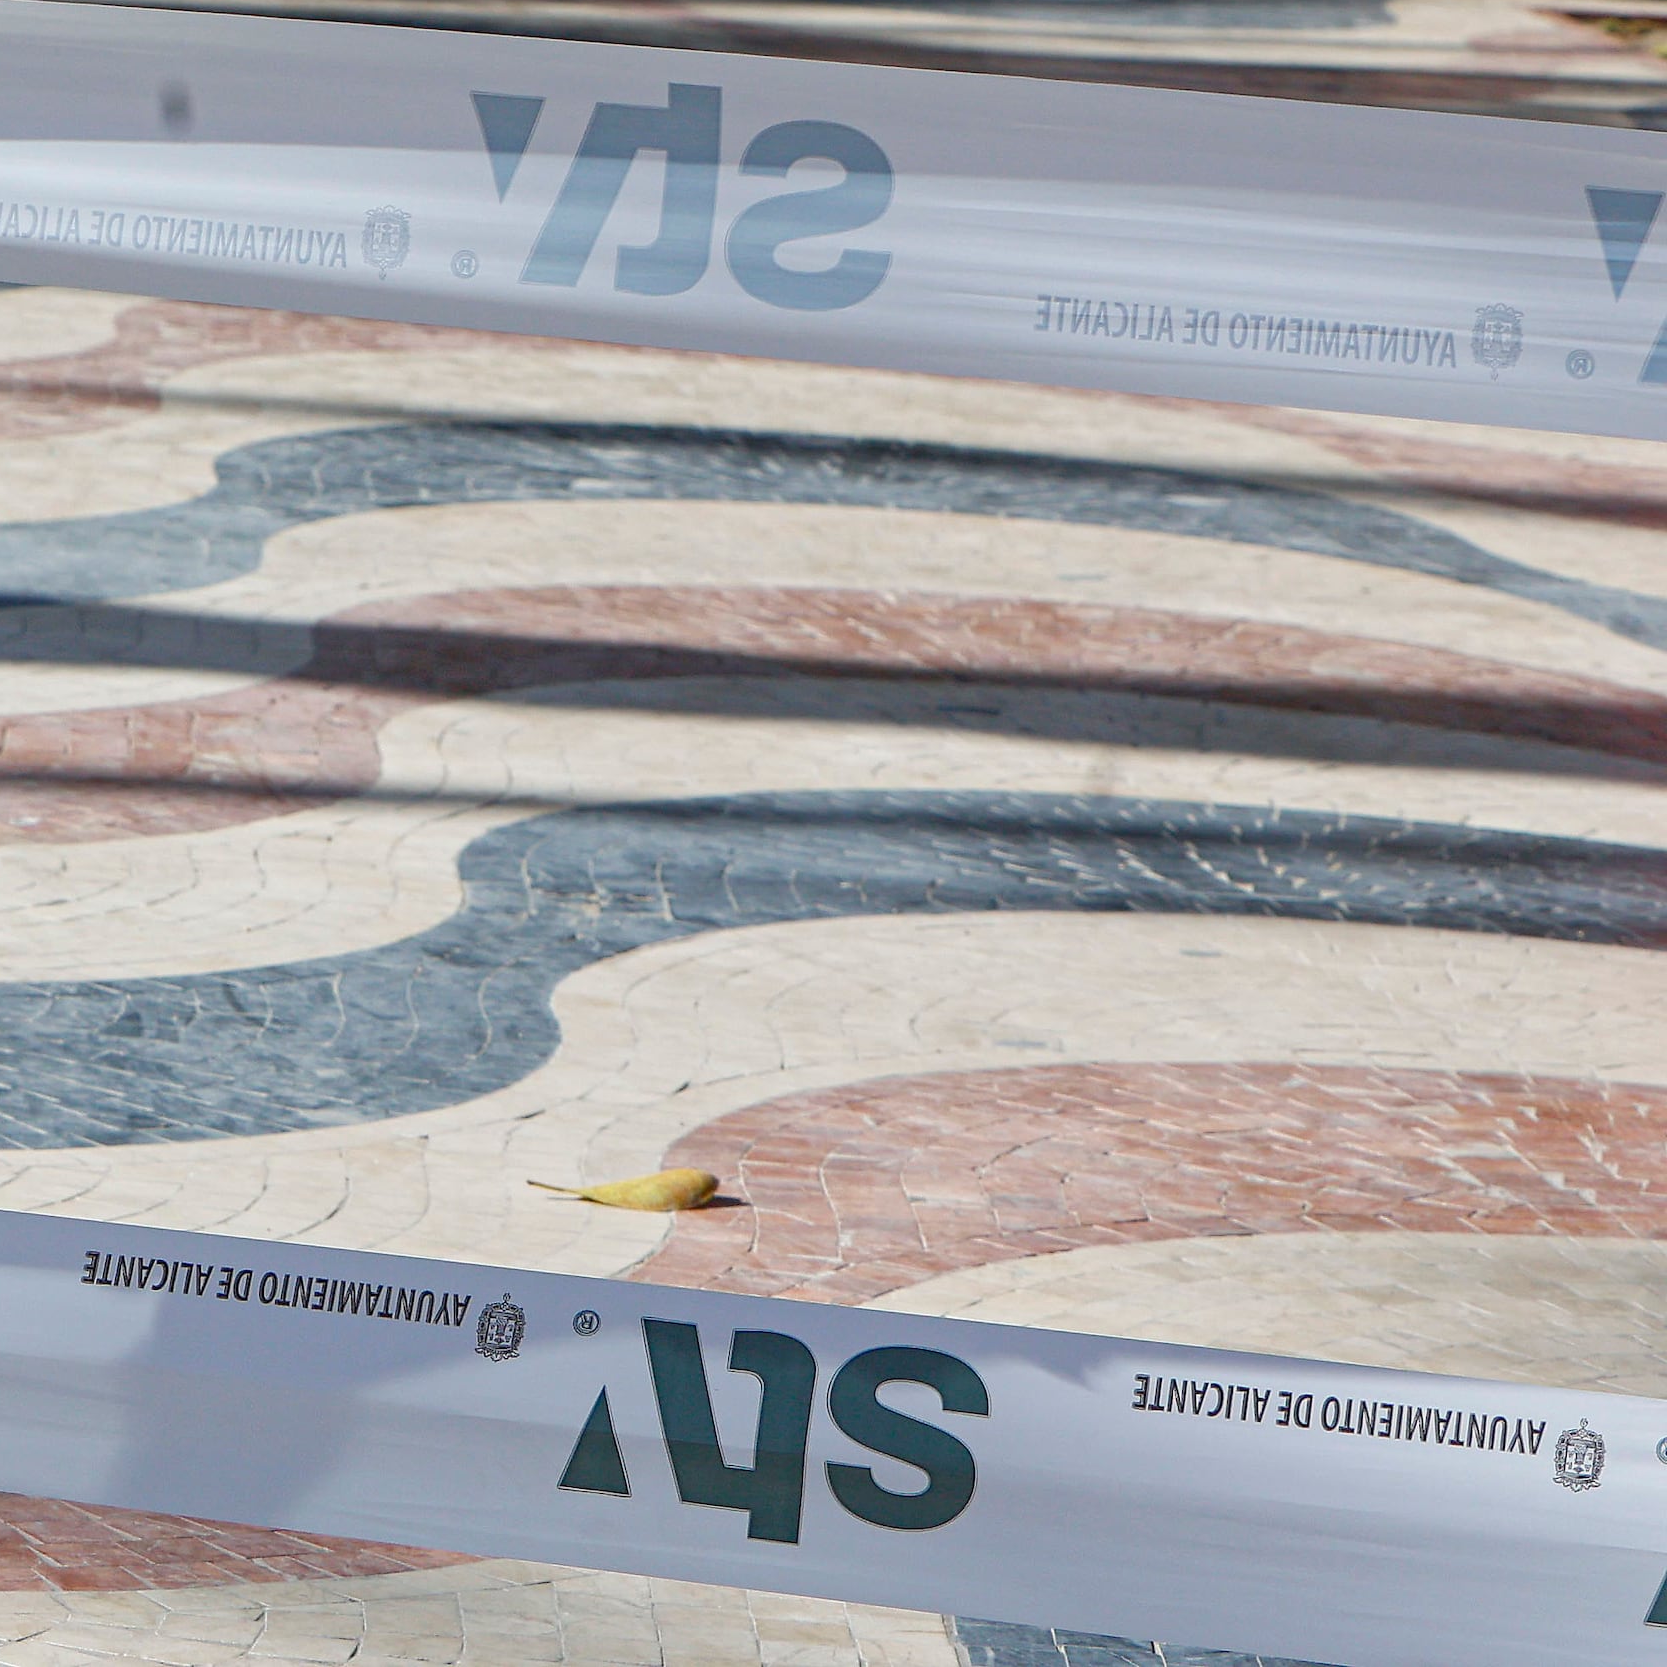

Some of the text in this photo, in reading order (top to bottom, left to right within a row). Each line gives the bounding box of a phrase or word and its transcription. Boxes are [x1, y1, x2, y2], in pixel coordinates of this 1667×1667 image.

[80, 1250, 472, 1327] AYUNTAMIENTO DE ALICANTE
[1131, 1373, 1546, 1455] AYUNTAMIENTO DE ALICANTE
